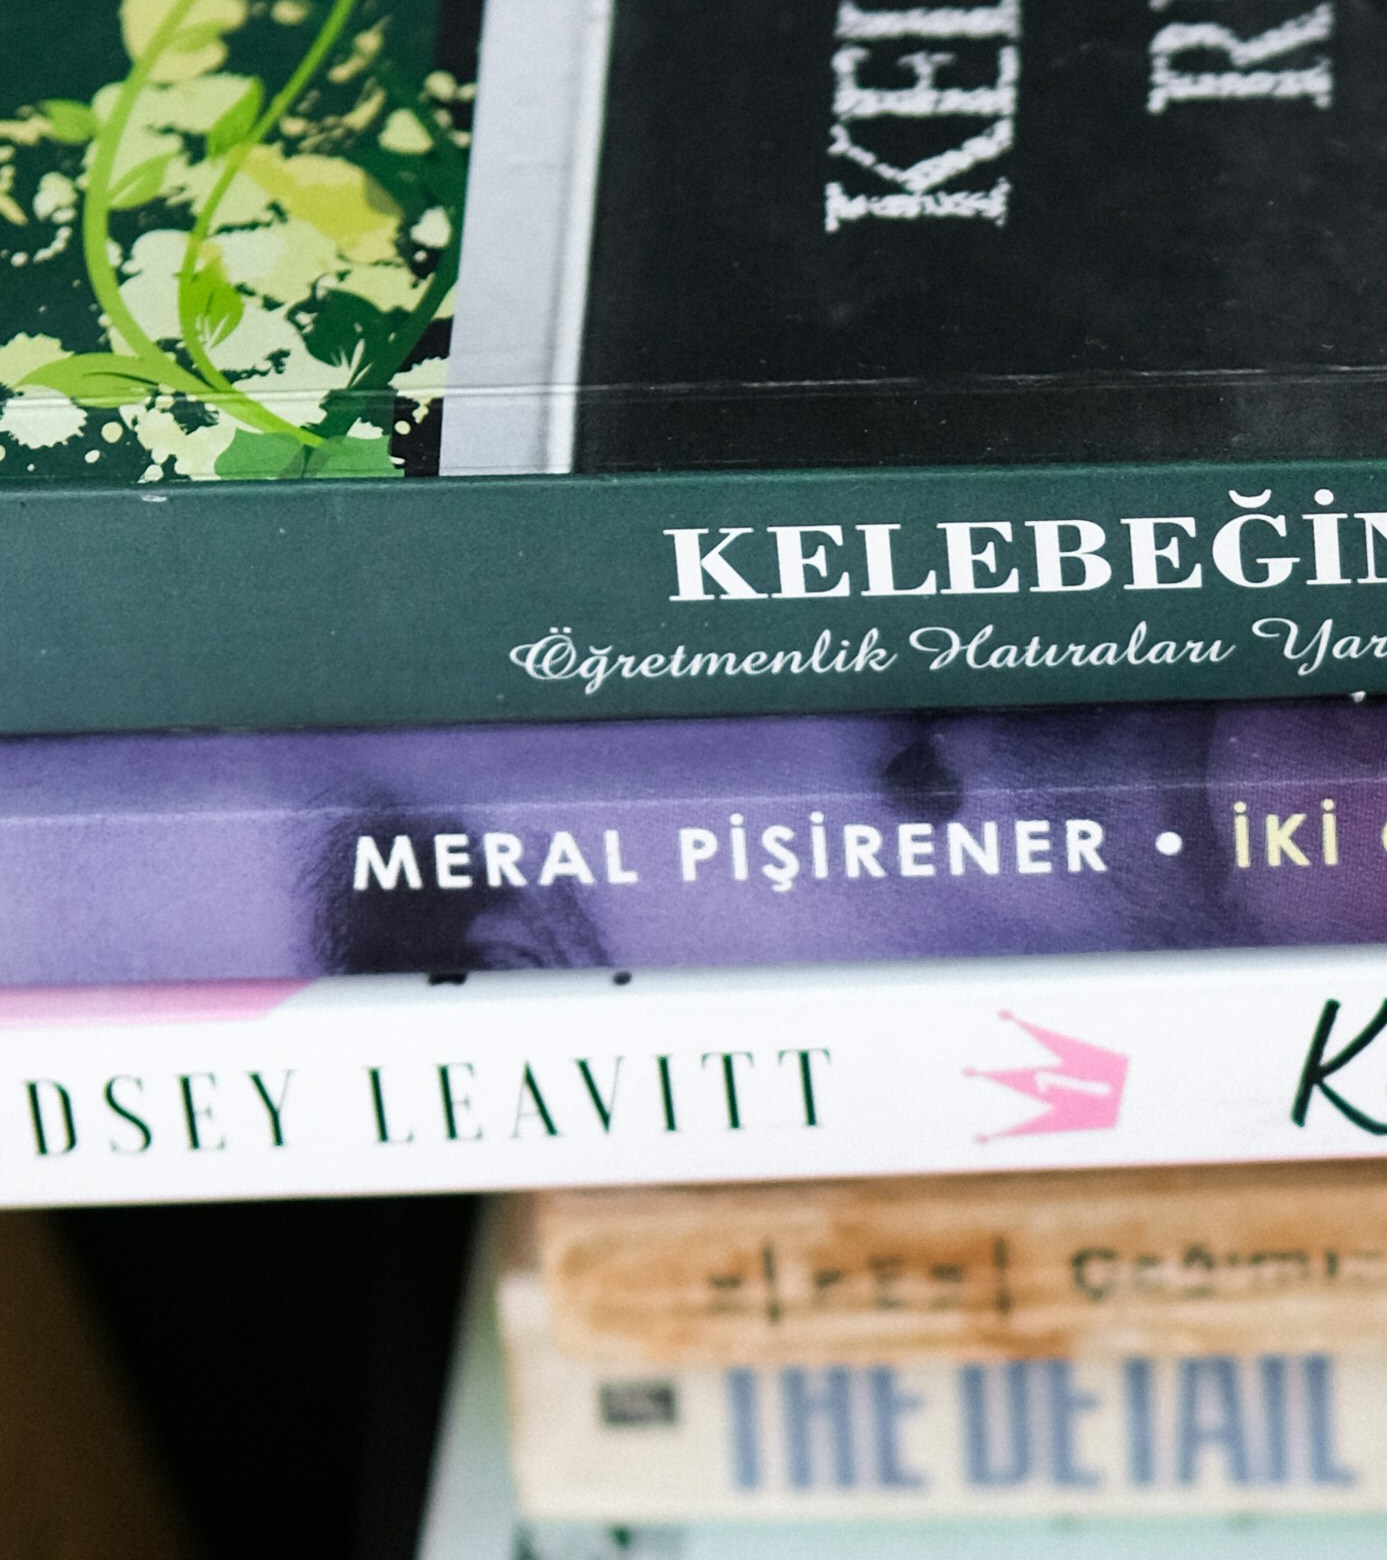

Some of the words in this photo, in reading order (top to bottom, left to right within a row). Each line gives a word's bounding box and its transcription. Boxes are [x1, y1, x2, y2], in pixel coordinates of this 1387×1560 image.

[508, 625, 899, 694] Öğretmenlik
[907, 619, 1239, 672] Hatıraları
[352, 828, 639, 892] MERAL
[679, 810, 1108, 892] PİŞİRENER
[1232, 796, 1341, 869] İKİ
[24, 1068, 298, 1158] DSEY
[366, 1045, 834, 1145] LEAVITT
[722, 1362, 928, 1494] THE
[956, 1348, 1358, 1492] DETAIL
